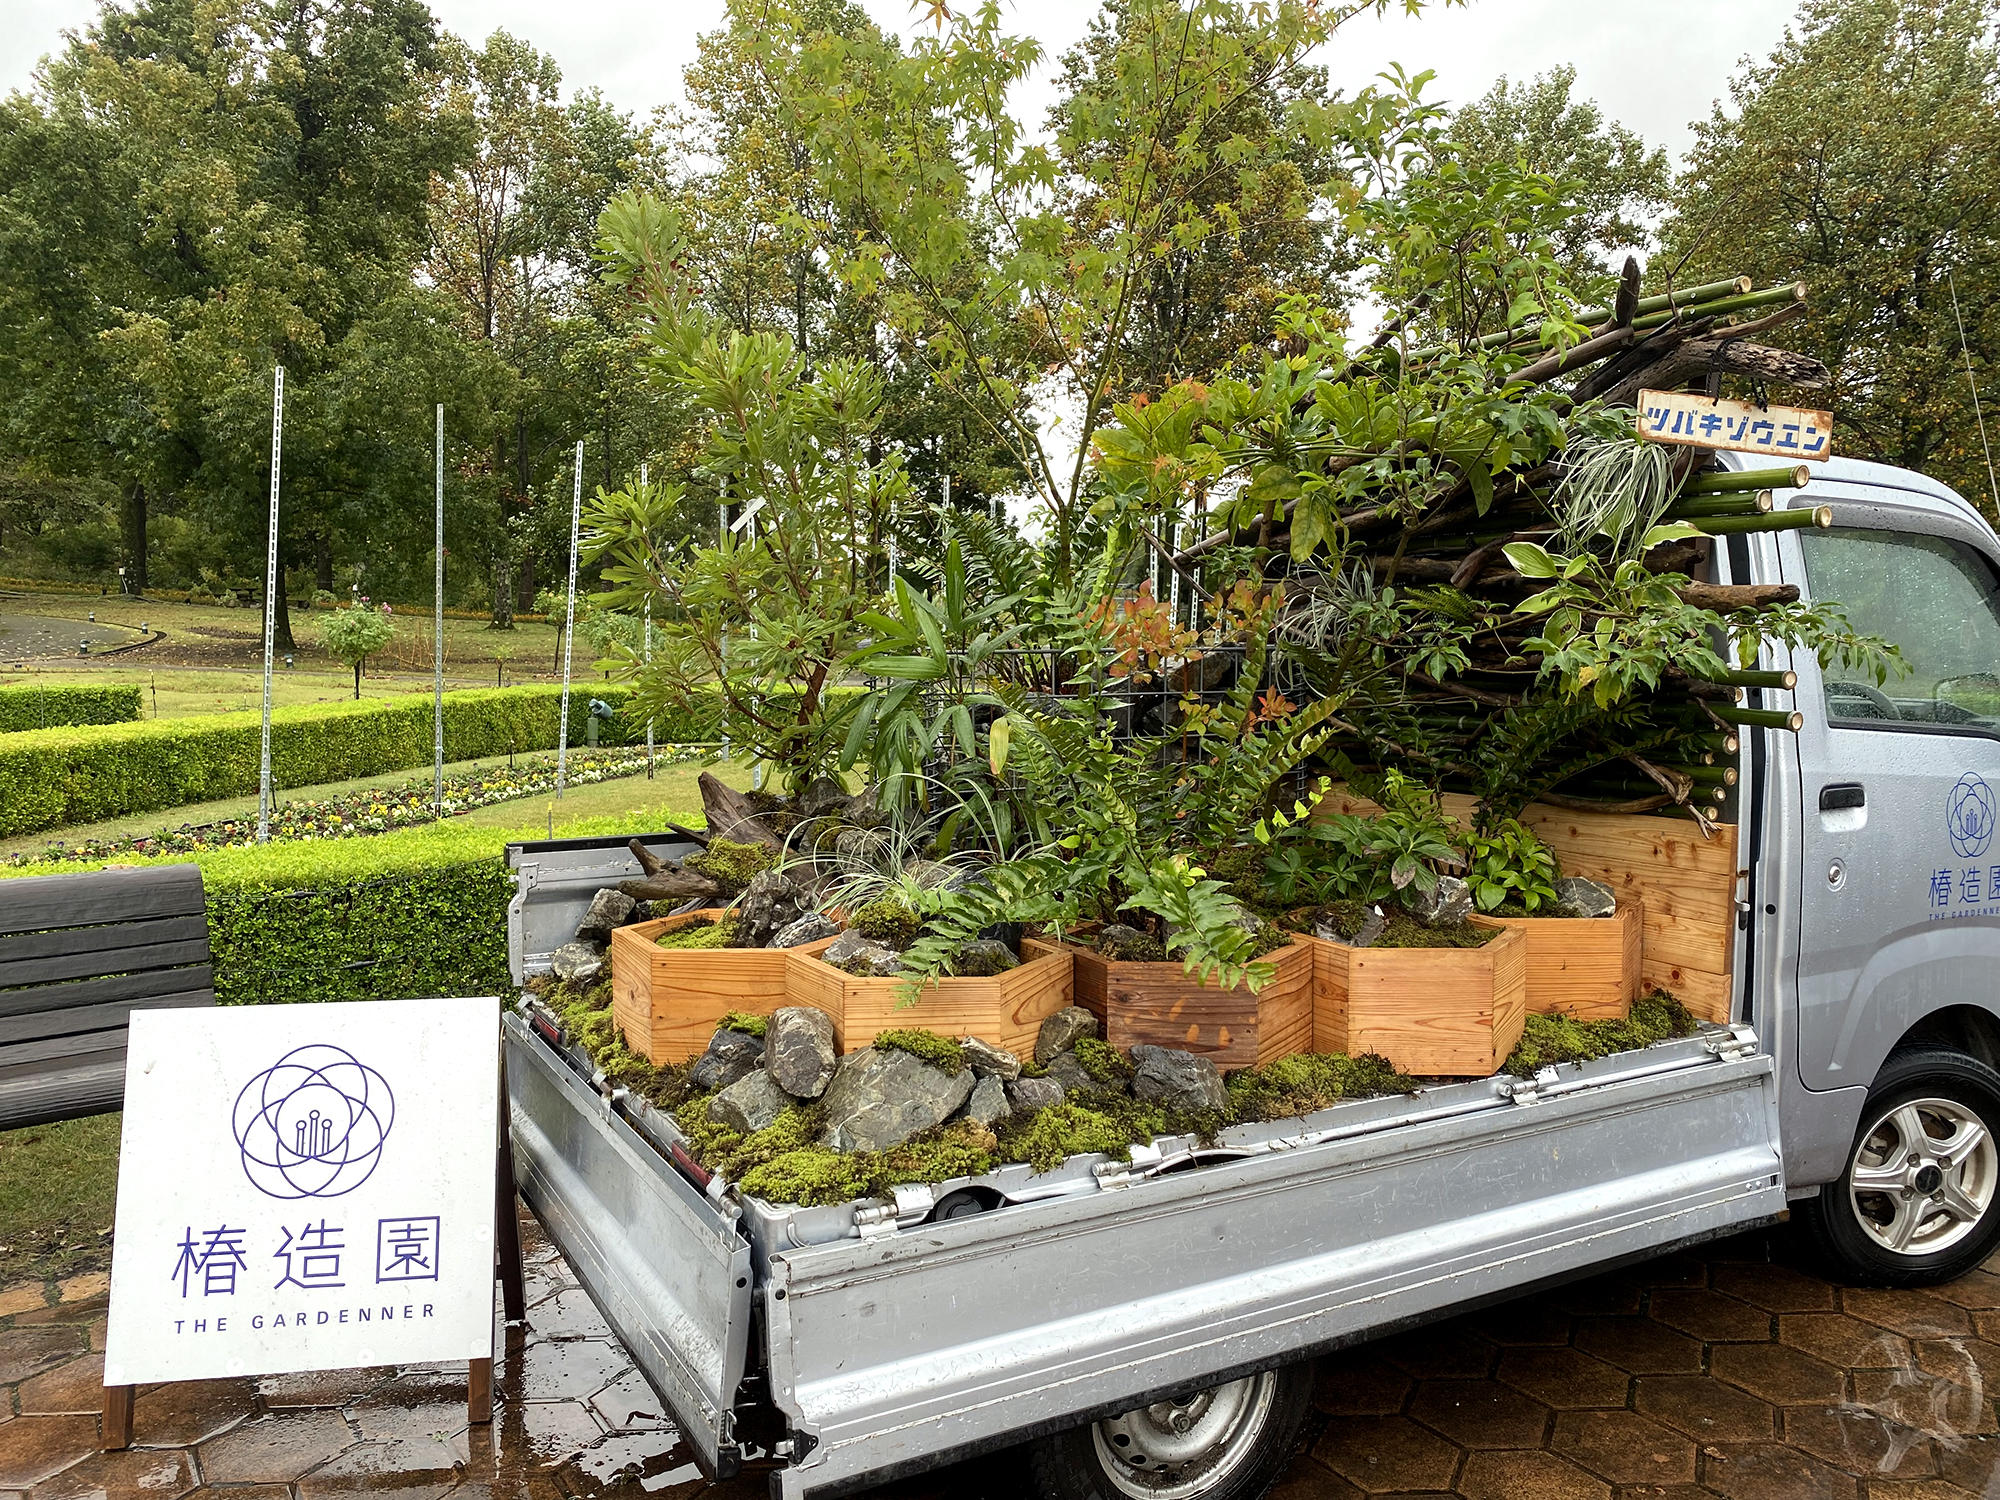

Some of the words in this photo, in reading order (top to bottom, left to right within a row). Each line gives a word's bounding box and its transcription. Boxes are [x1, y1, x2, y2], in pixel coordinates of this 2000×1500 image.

[1647, 407, 1825, 451] ツバキゾウエン
[1928, 912, 1946, 921] THE
[1951, 906, 2000, 919] GARDENNE
[171, 1215, 441, 1298] 椿造園
[174, 1317, 228, 1334] THE
[251, 1303, 434, 1329] GARDENNER
